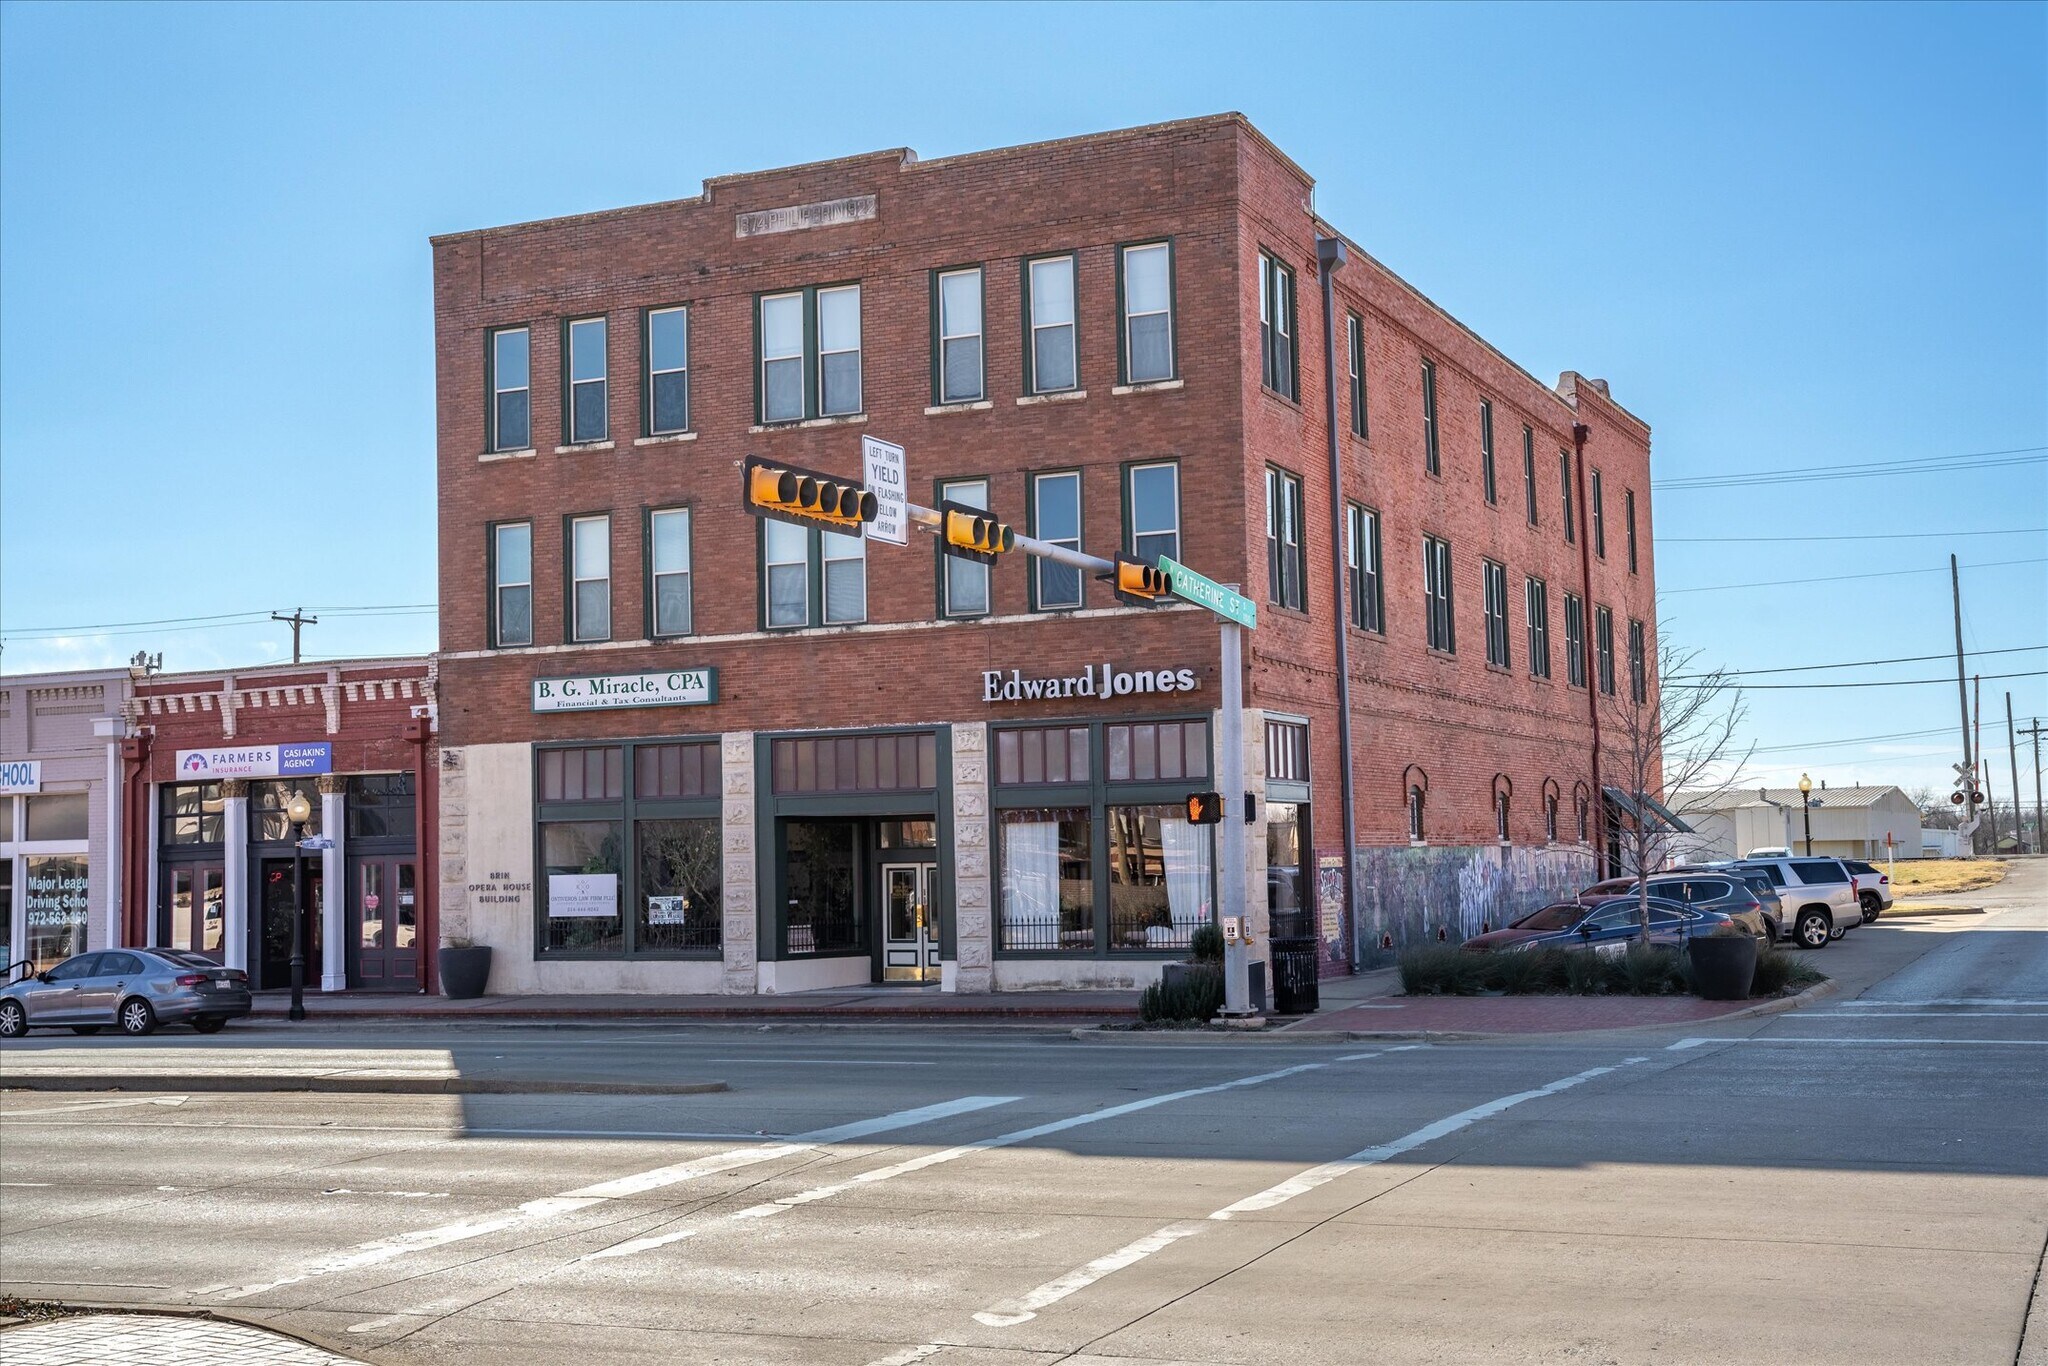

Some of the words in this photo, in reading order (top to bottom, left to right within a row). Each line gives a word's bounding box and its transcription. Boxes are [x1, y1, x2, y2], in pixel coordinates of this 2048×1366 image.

[869, 446, 882, 459] LEFT
[885, 450, 900, 464] TURN
[871, 463, 899, 485] YIELD
[878, 487, 904, 503] FLASHING
[879, 504, 897, 518] ELLOW
[877, 521, 897, 534] ARROW
[1176, 571, 1225, 609] CATHERINE
[1229, 597, 1240, 615] ST
[539, 682, 555, 698] B.
[562, 680, 581, 696] G.
[589, 676, 660, 695] Miracle,
[666, 673, 704, 691] CPA
[981, 665, 1096, 702] Edward
[1099, 663, 1195, 700] Jones
[557, 699, 598, 708] Financial
[612, 697, 629, 705] Tax
[632, 695, 687, 704] Consultants
[212, 751, 272, 764] FARMERS
[284, 749, 301, 758] CASI
[301, 747, 326, 757] AKINS
[212, 765, 252, 774] INSURANCE
[284, 758, 315, 769] AGENCY
[0, 763, 34, 786] HOOL
[490, 872, 510, 880] BRIN
[28, 876, 56, 893] Major
[58, 876, 88, 891] Leagu
[468, 884, 497, 892] OPERA
[503, 883, 532, 891] HOUSE
[27, 895, 61, 911] Driving
[62, 893, 88, 908] Scho
[479, 895, 520, 903] BUILDING
[28, 911, 88, 925] 972-563-360
